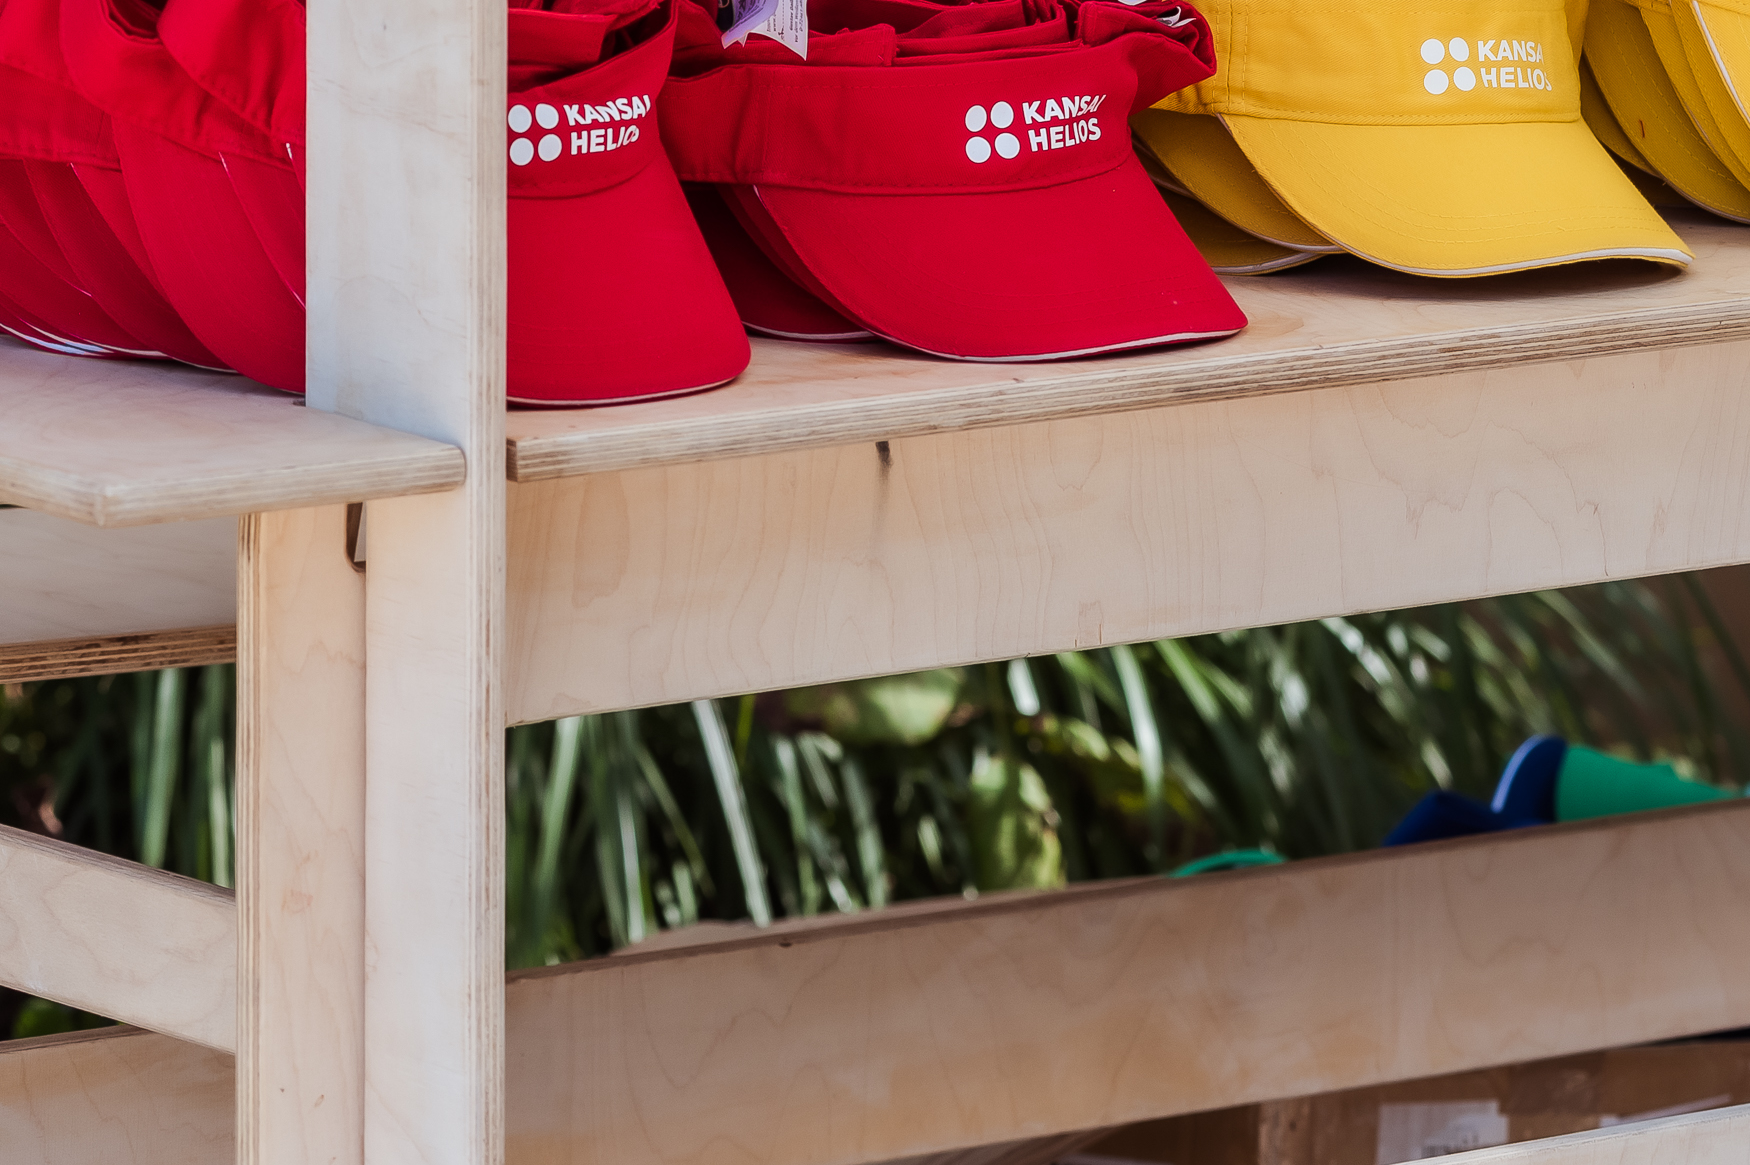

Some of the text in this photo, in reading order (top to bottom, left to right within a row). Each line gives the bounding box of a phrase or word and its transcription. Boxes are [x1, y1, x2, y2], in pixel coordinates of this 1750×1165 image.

[1477, 39, 1544, 64] KANSA
[563, 94, 652, 127] KANSAI
[1022, 94, 1107, 125] KANSAI
[1028, 117, 1102, 153] HELIOS
